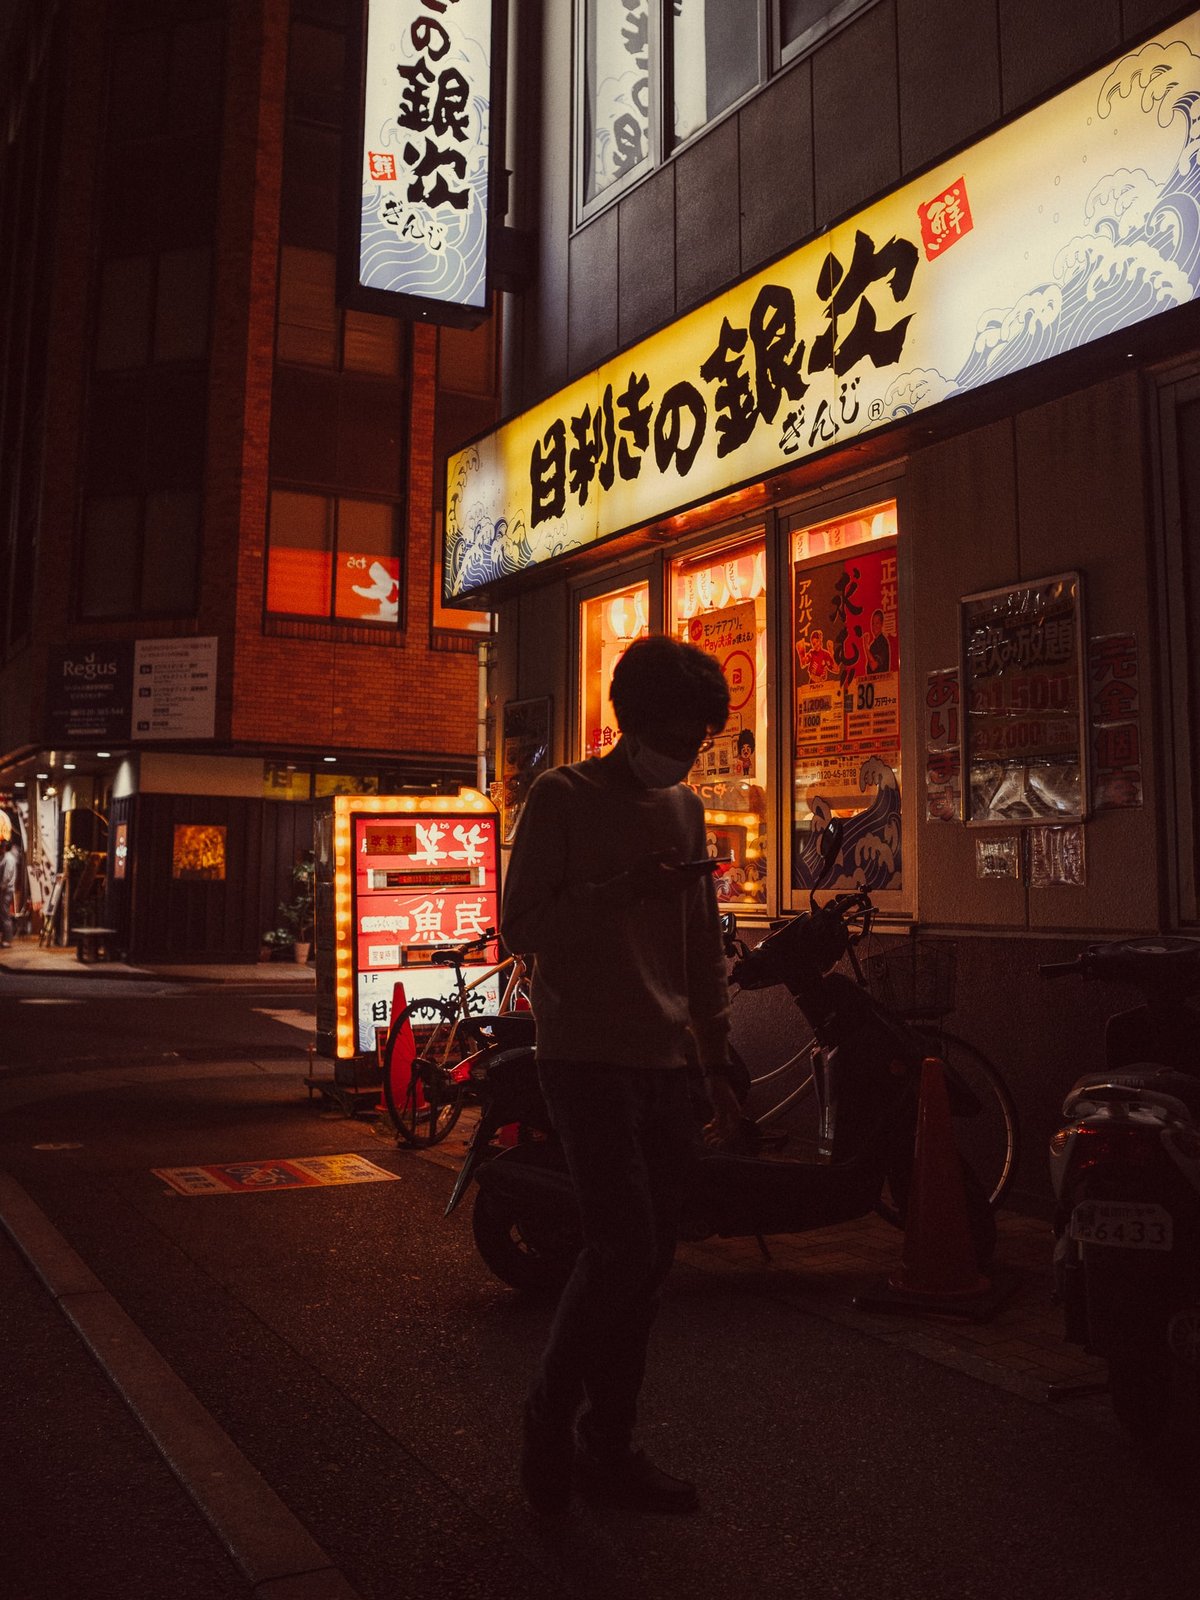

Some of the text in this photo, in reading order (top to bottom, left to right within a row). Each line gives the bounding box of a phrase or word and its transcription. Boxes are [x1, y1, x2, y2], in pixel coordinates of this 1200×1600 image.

[397, 0, 471, 210] の銀次
[382, 200, 444, 250] ぎんじ
[529, 229, 921, 528] 目利きの銀次
[779, 376, 862, 456] ぎんじ
[704, 617, 743, 636] モンテアプリで
[799, 578, 813, 648] アルバイト
[880, 557, 897, 637] 正社員
[63, 653, 117, 680] Regus
[409, 900, 491, 942] 魚民
[363, 974, 379, 983] 1F
